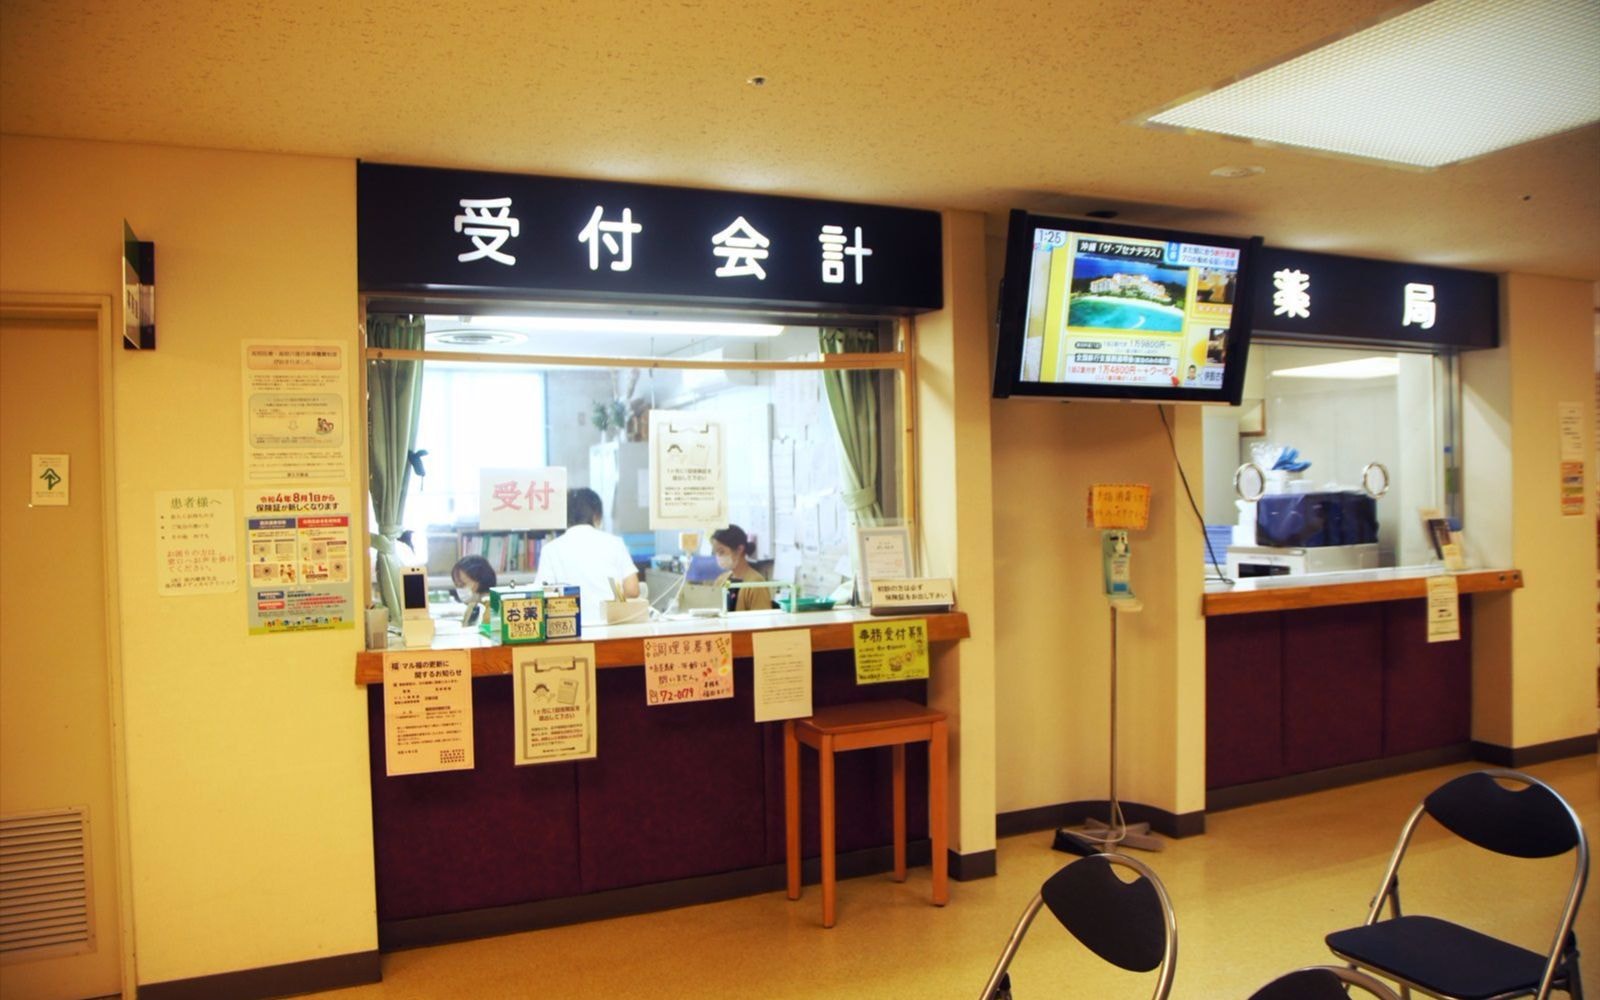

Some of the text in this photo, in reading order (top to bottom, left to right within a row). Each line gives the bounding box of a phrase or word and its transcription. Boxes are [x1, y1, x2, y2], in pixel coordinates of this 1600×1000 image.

[453, 197, 873, 286] 受付会計
[1038, 230, 1062, 244] 1:25
[1273, 268, 1436, 330] 薬局
[171, 496, 222, 509] 患者様へ
[260, 492, 336, 503] 令和4年8月1日から
[492, 480, 555, 512] 受付
[256, 502, 339, 513] 保険証が新しくなります
[506, 606, 538, 623] お薬
